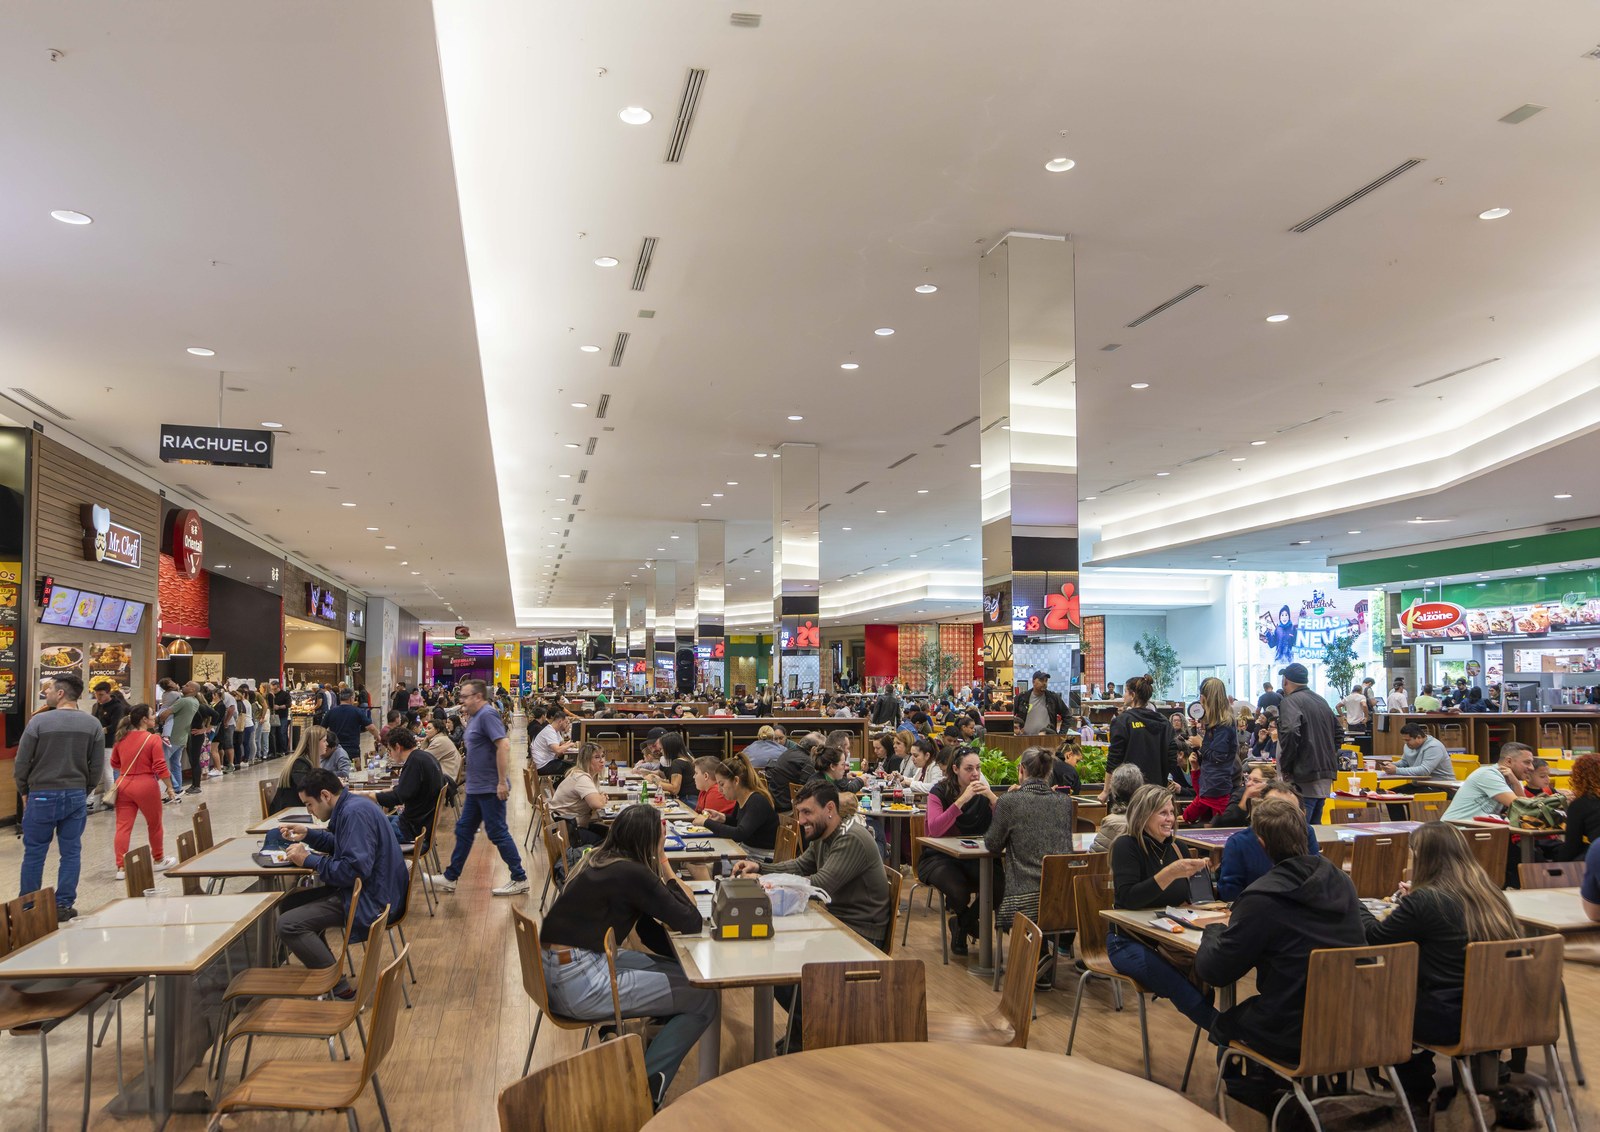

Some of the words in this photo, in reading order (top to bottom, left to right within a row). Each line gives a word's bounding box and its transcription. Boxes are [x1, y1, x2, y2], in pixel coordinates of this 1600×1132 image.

[162, 435, 268, 453] RIACHUELO
[108, 531, 120, 552] Mr.
[121, 536, 139, 561] Cheff
[1298, 616, 1340, 630] FÉRIAS
[1407, 598, 1453, 632] Kalzone
[544, 646, 572, 656] McDonald's
